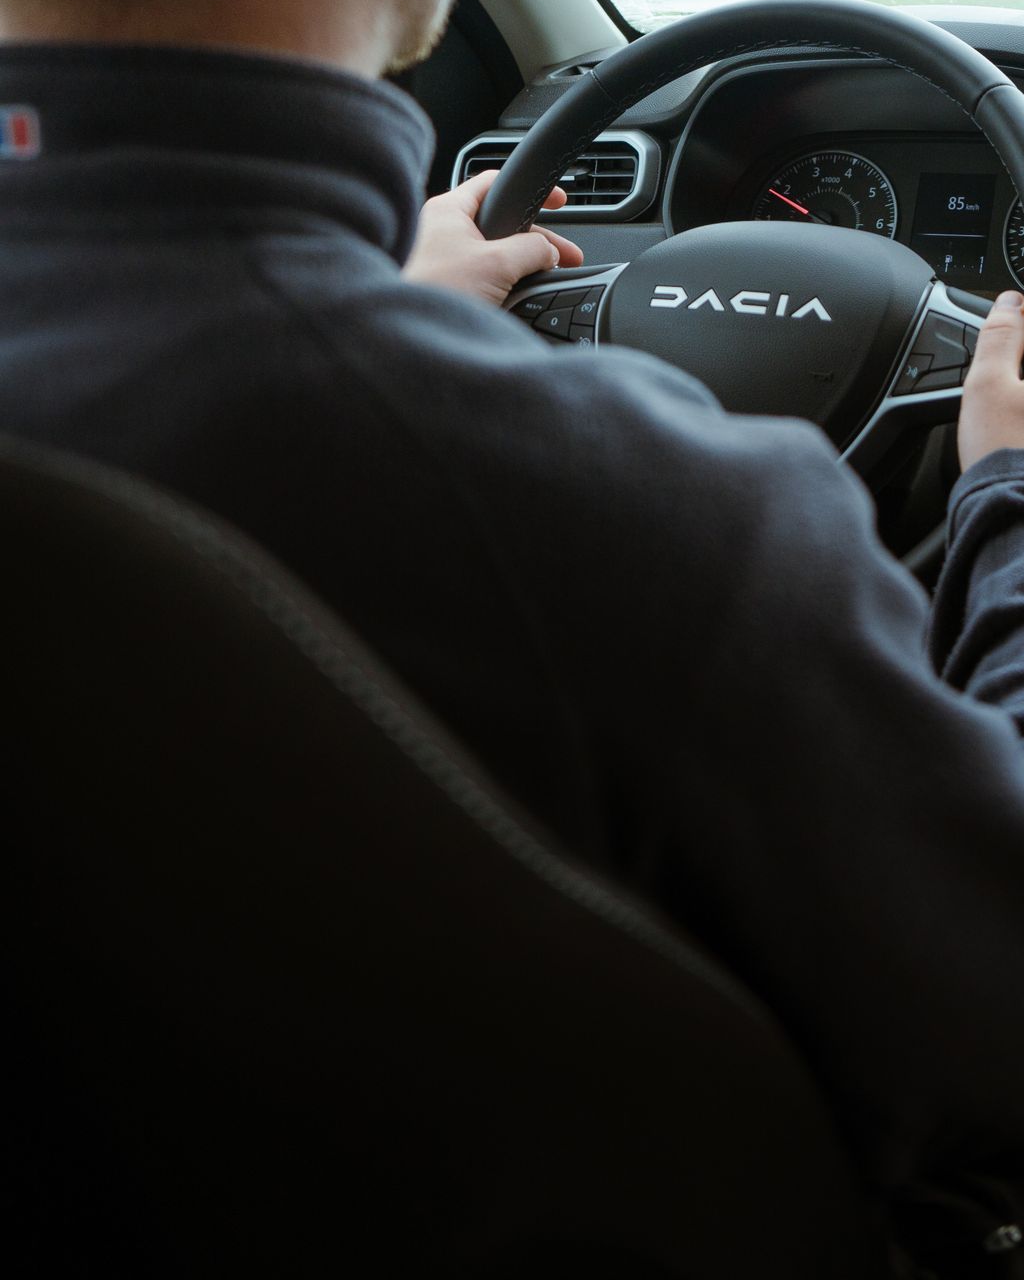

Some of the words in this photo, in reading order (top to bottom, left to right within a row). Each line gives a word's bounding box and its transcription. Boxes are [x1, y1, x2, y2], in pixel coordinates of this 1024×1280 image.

[811, 167, 820, 178] 3
[844, 168, 852, 179] 4
[783, 184, 791, 195] 2
[868, 187, 876, 198] 5
[948, 196, 965, 210] 85
[875, 218, 884, 230] 6
[650, 285, 832, 321] DACIA
